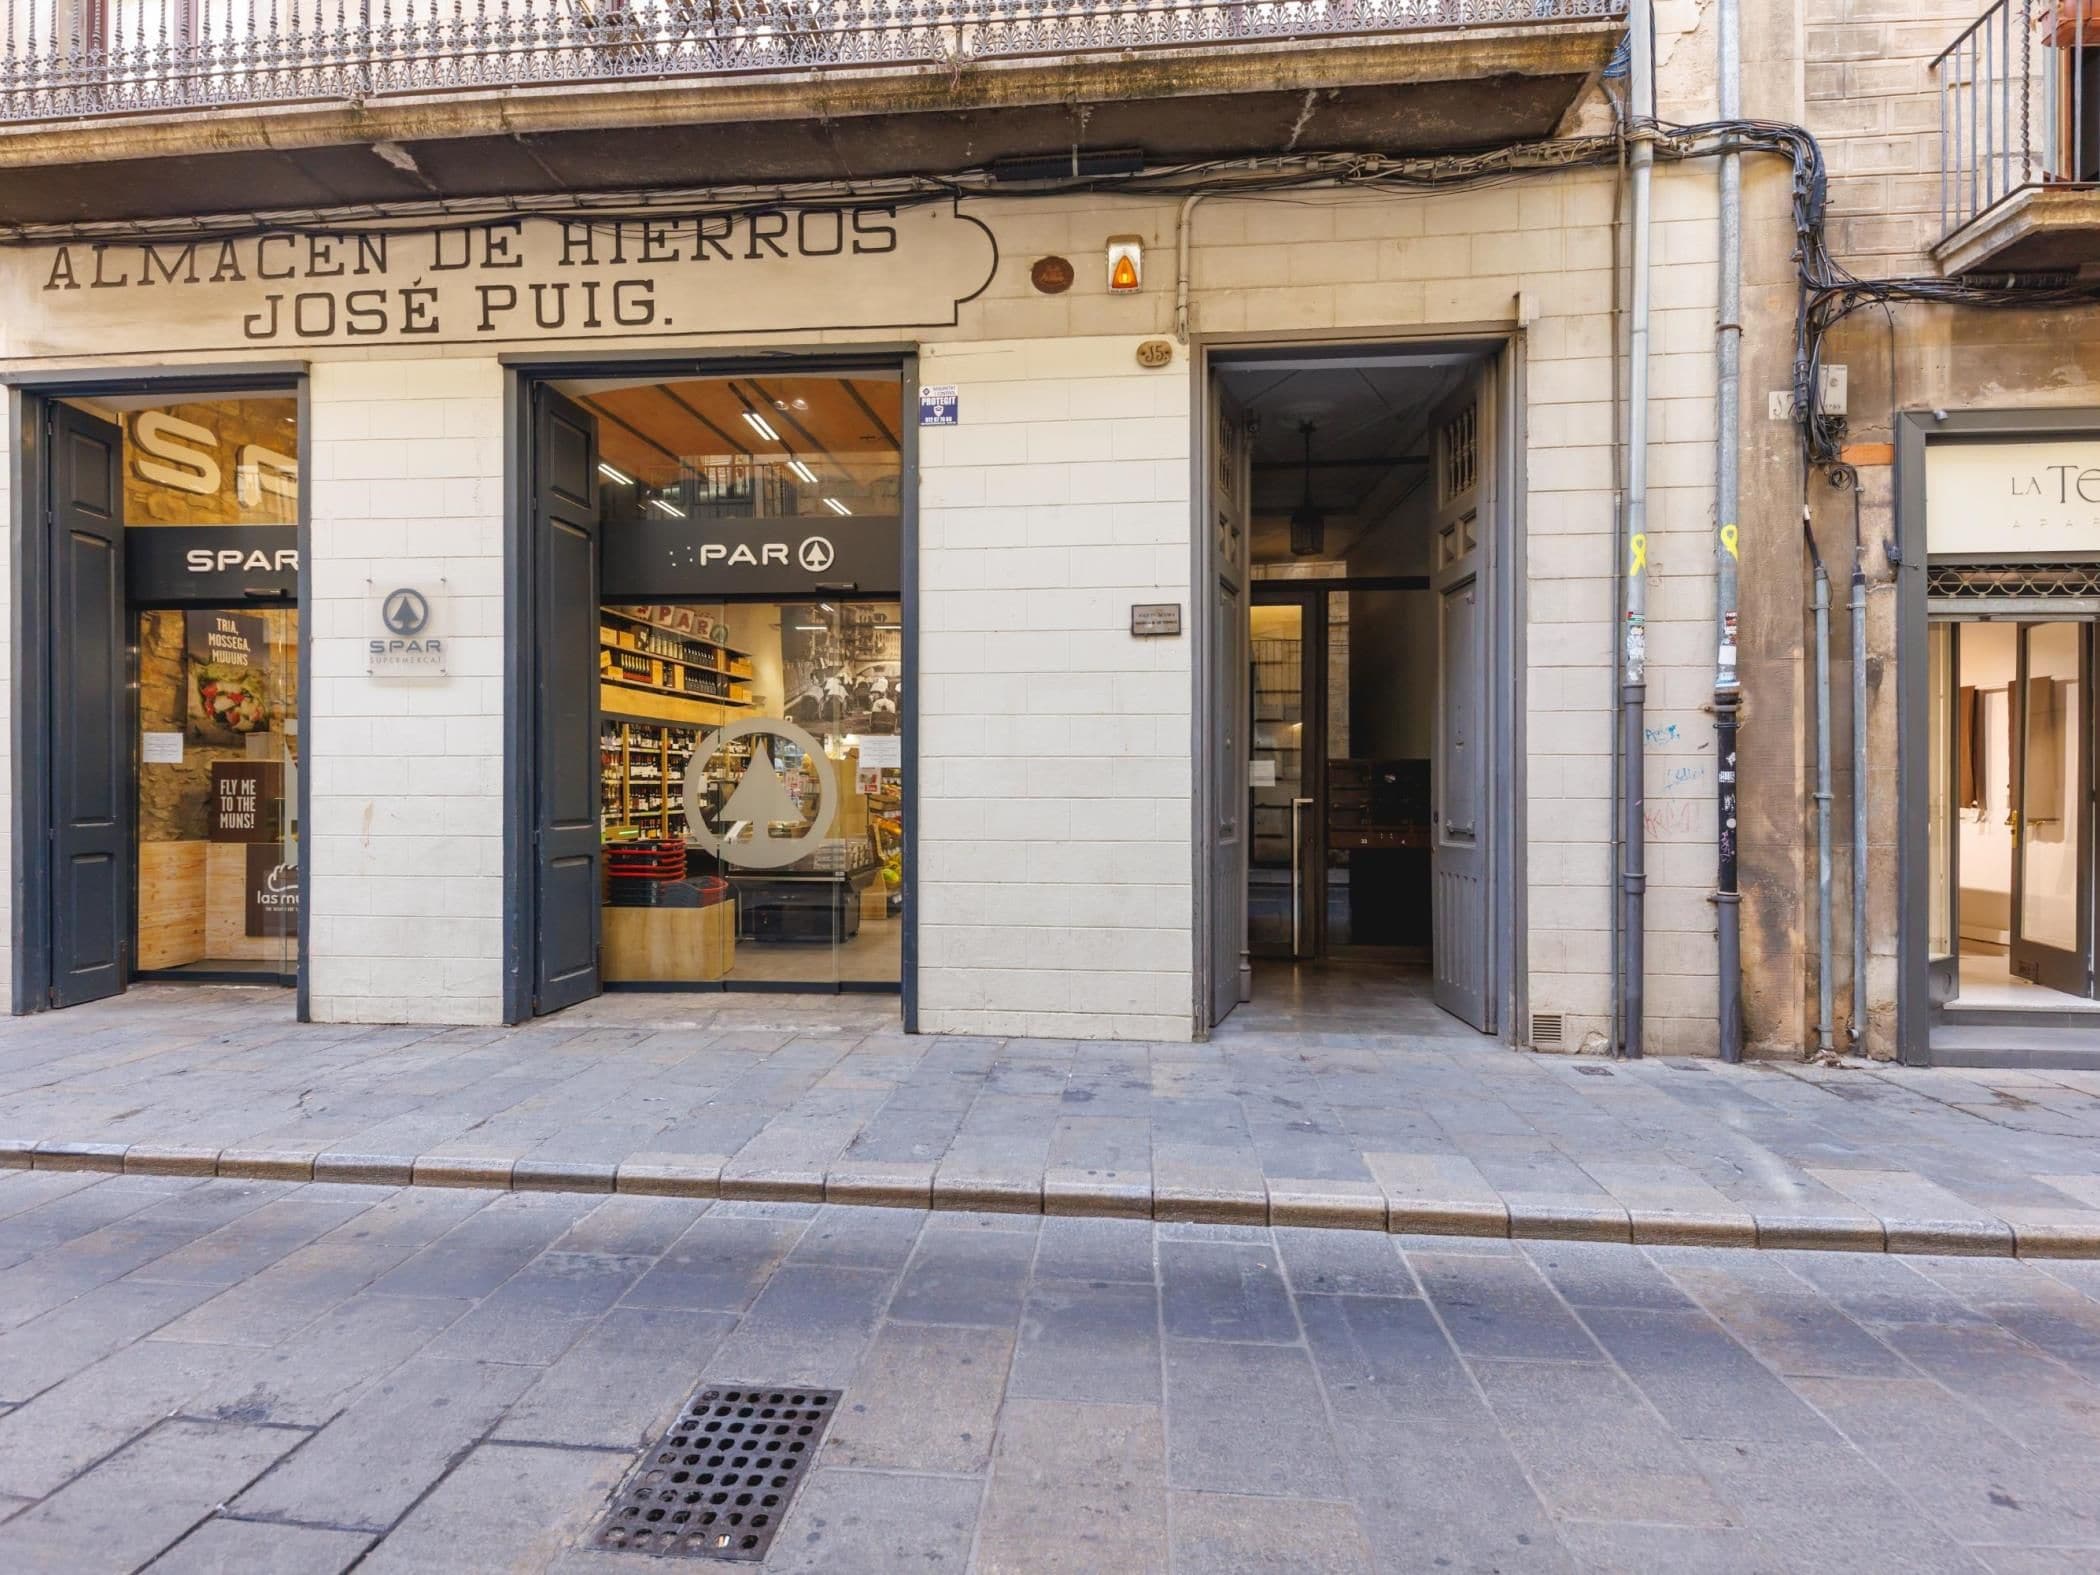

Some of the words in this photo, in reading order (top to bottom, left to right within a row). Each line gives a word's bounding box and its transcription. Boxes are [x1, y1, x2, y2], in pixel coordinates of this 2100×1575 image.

[43, 229, 388, 290] ALMACEN
[430, 221, 522, 271] DE
[558, 204, 897, 266] HIERROS
[244, 276, 439, 339] JOSÉ
[475, 279, 673, 331] PUIG.
[2011, 476, 2042, 496] LA
[186, 549, 299, 572] SPAR
[700, 543, 790, 567] PAR
[208, 632, 251, 653] MOSSEGA,
[369, 639, 442, 653] SPAR
[212, 649, 248, 666] MUUUNS
[220, 779, 238, 795] FLY
[241, 779, 257, 795] ME
[220, 796, 234, 812] TO
[236, 796, 257, 812] THE
[220, 813, 255, 829] MUNS!
[257, 890, 279, 904] las
